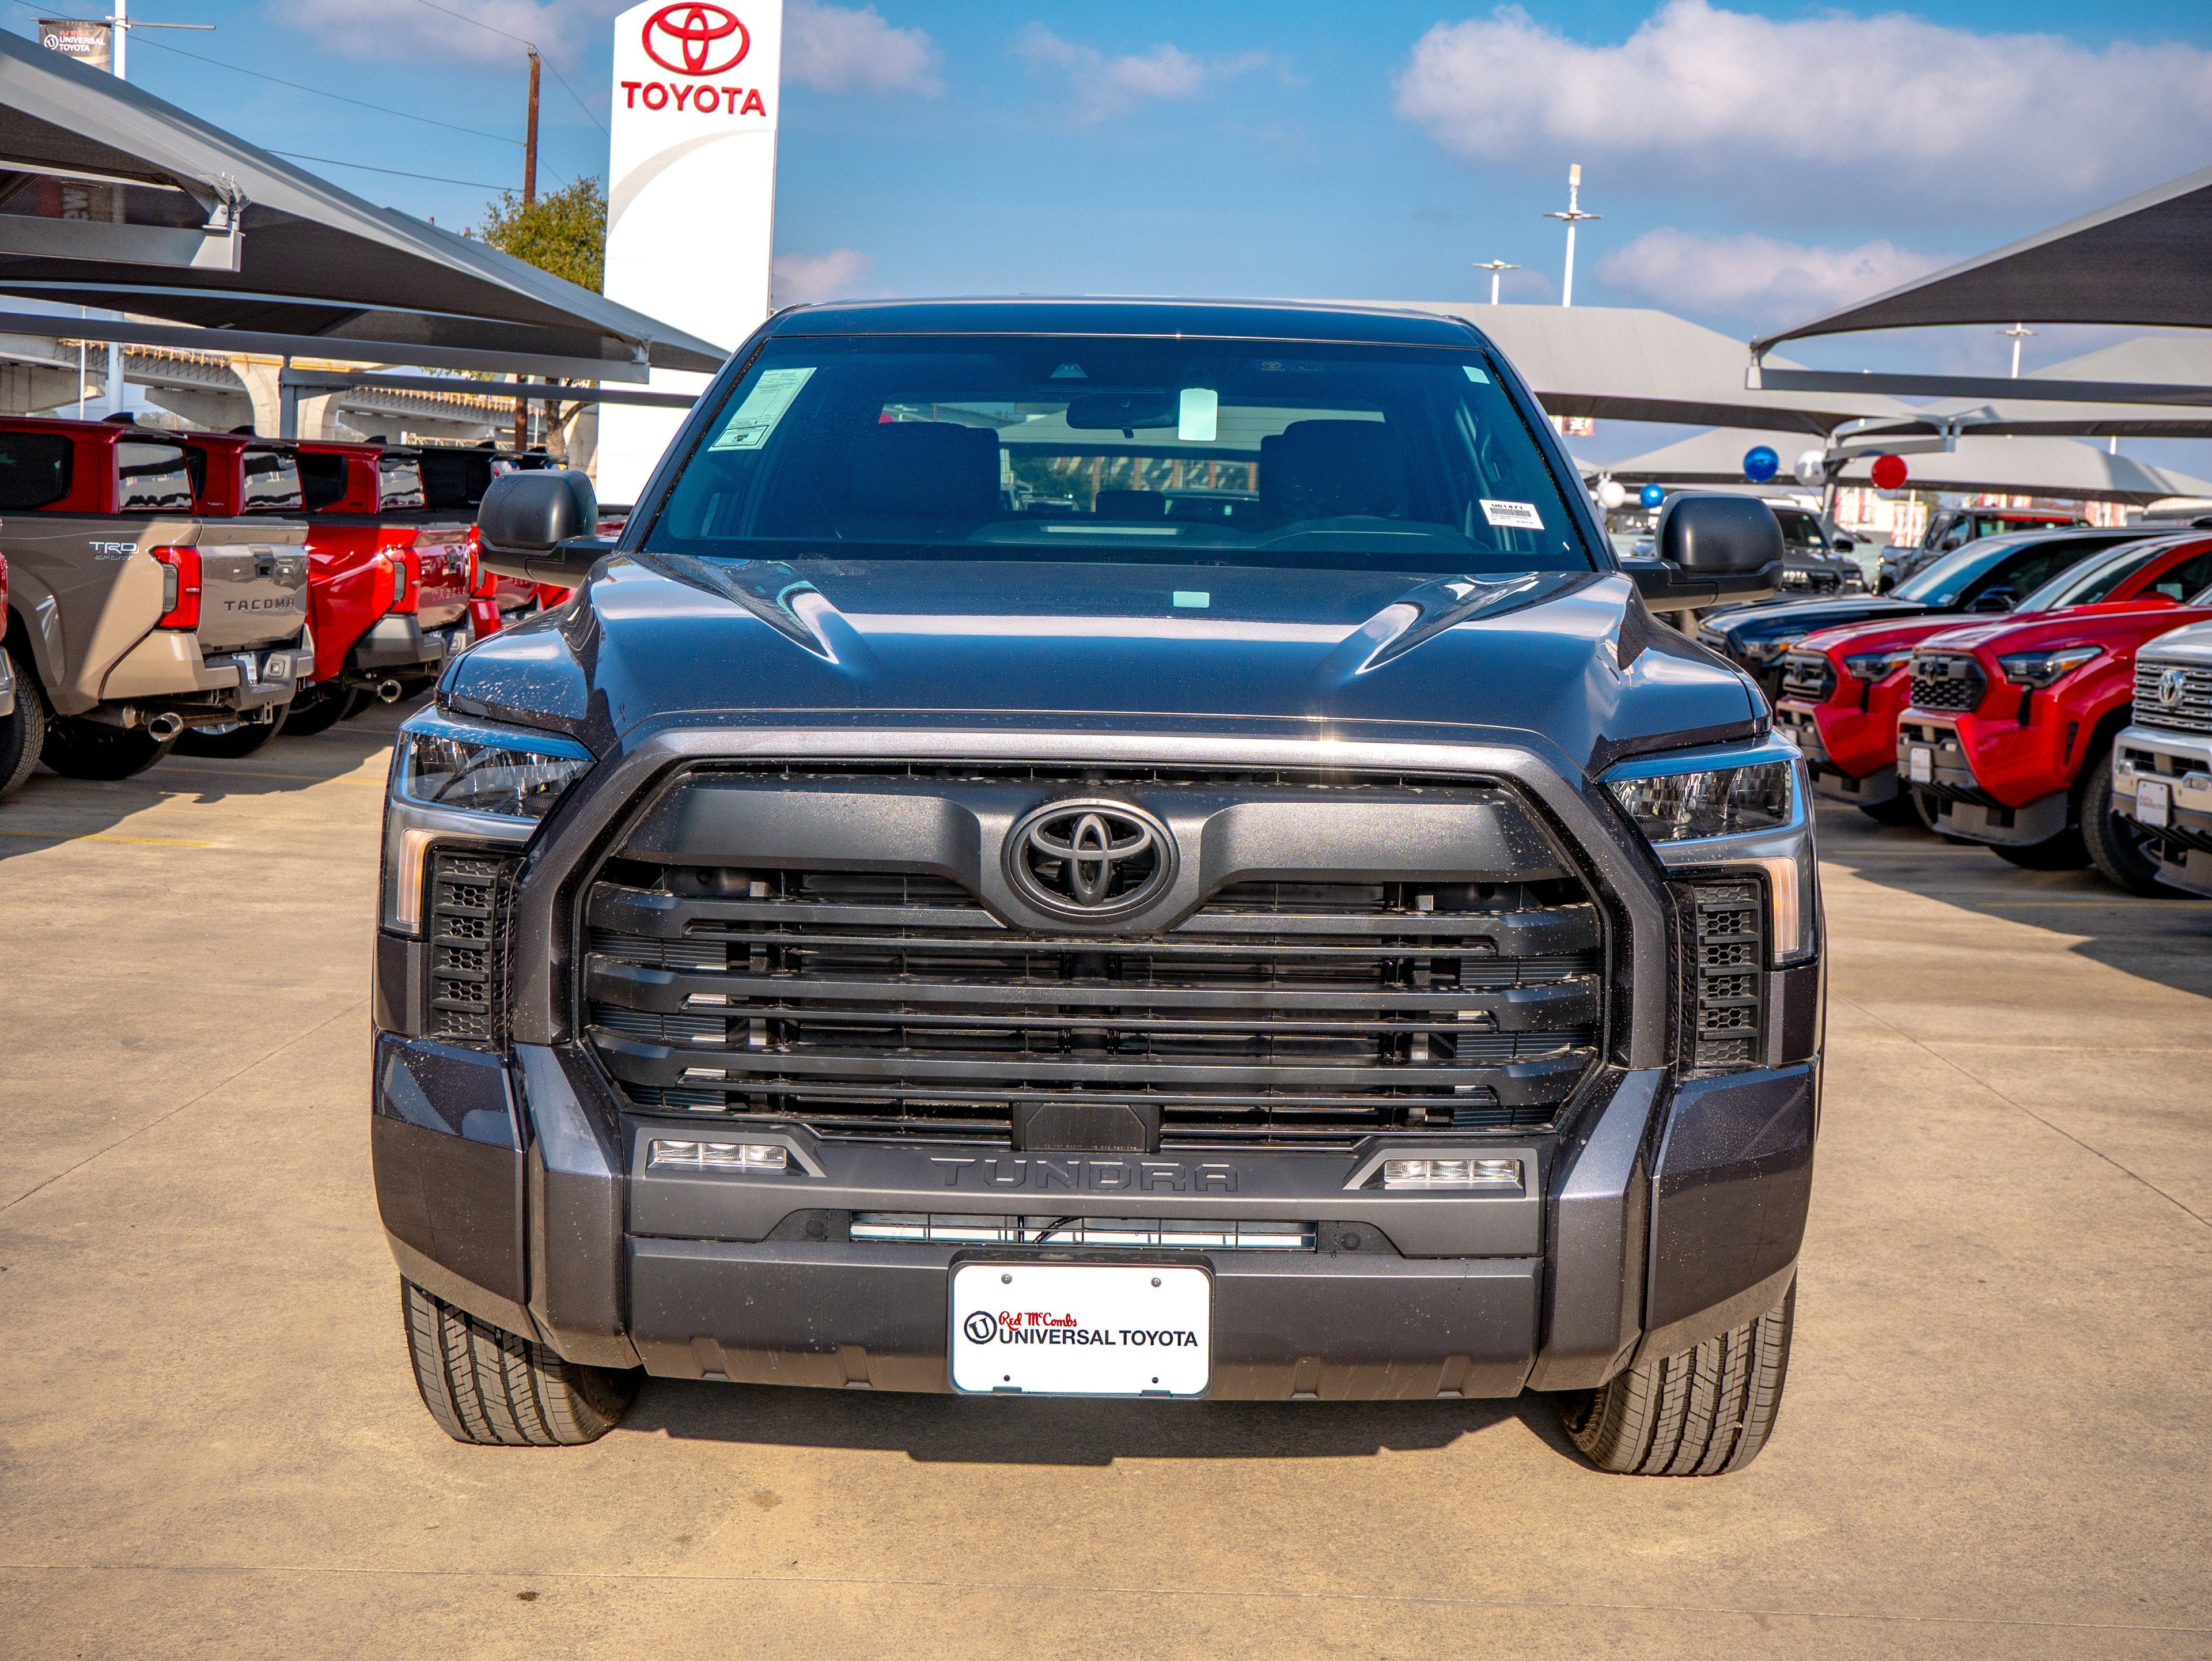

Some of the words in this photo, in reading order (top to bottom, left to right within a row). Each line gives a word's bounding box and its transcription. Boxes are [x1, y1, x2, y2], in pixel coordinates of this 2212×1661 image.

[59, 36, 106, 46] UNIVERSAL
[59, 44, 90, 52] TOYOTA
[621, 81, 767, 116] TOYOTA
[89, 542, 138, 554] TRD
[1783, 571, 1808, 579] YOTA
[224, 598, 295, 612] TACOMA
[930, 1157, 1238, 1192] TUNDRA
[999, 1311, 1022, 1331] Red
[1024, 1312, 1077, 1327] McCombs
[999, 1329, 1116, 1345] UNIVERSAL
[1119, 1330, 1199, 1346] TOYOTA
